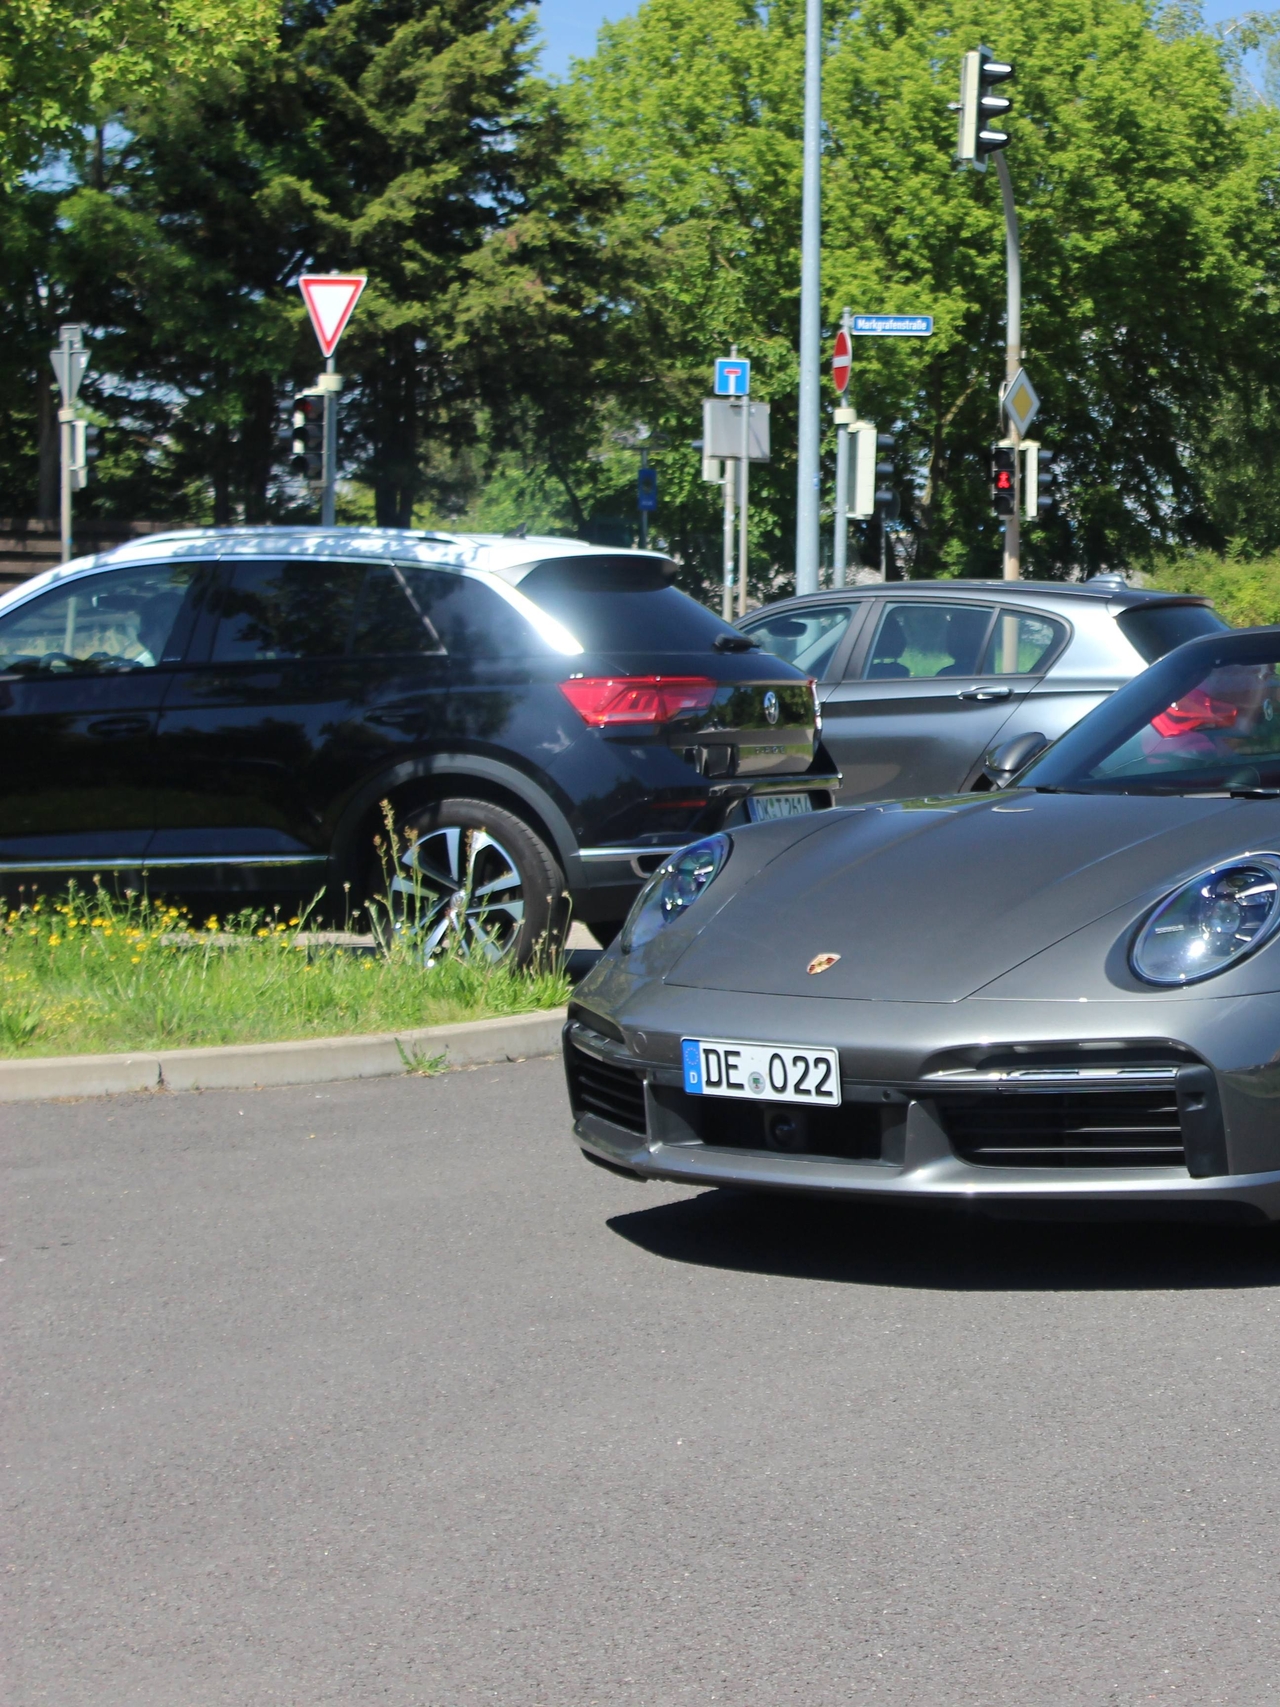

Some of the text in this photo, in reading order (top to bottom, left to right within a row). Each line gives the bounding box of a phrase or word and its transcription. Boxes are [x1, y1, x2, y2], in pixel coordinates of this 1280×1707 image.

[857, 319, 927, 332] Markgrafenstraße
[702, 1048, 745, 1090] DE
[689, 1071, 698, 1084] D
